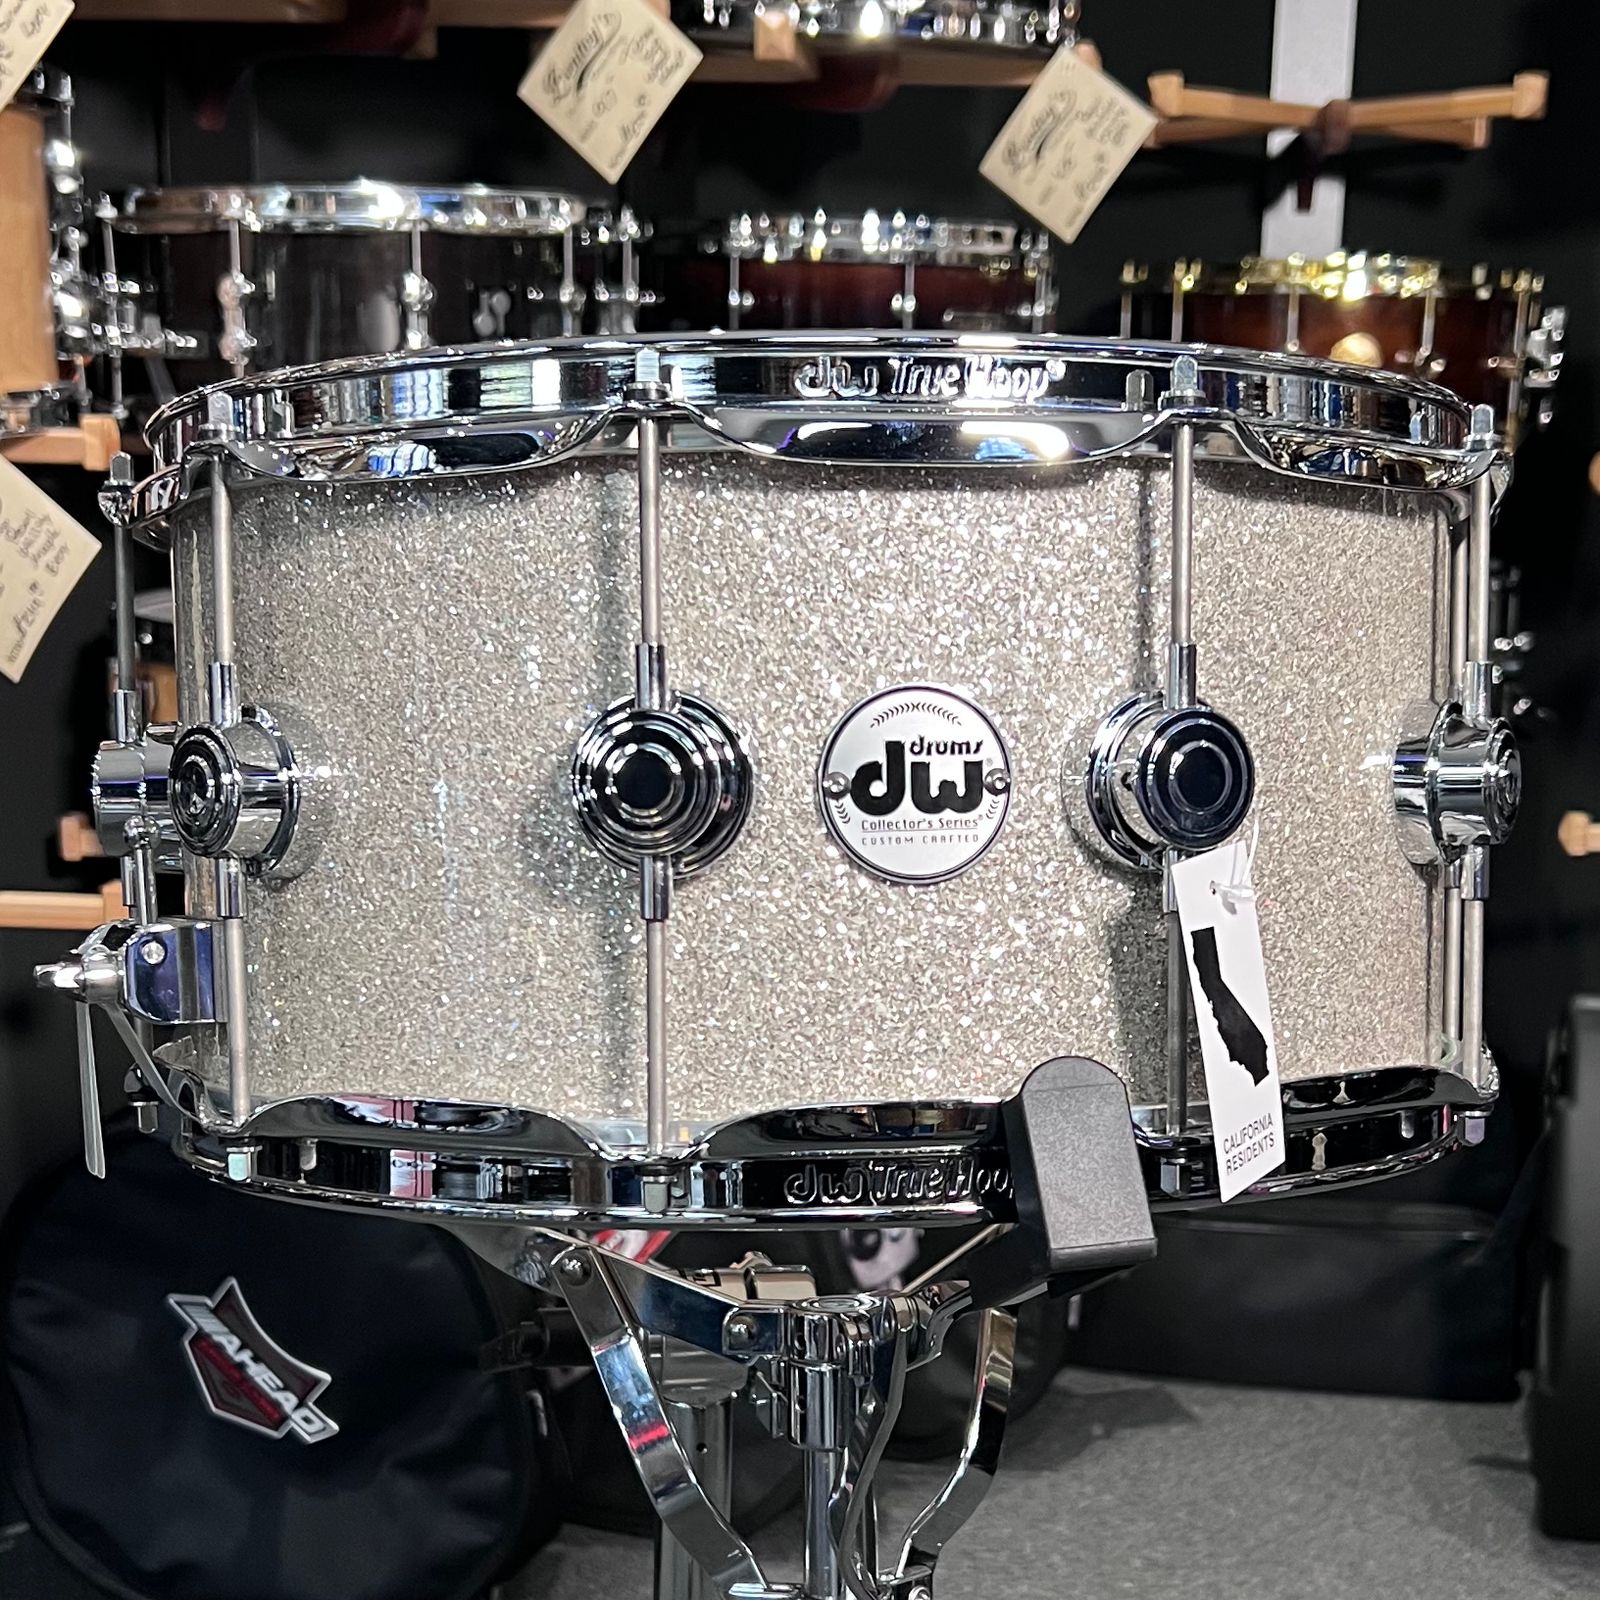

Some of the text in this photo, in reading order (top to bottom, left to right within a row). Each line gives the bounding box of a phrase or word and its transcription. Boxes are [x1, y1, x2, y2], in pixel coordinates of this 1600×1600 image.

[887, 355, 960, 396] True
[909, 734, 984, 756] drums
[850, 740, 984, 816] dw
[861, 818, 934, 831] Collector's
[861, 834, 979, 846] CUSTOM CRAFTED
[1223, 1112, 1274, 1155] CALIFORNIA
[1225, 1132, 1275, 1176] RESIDENTS
[874, 1163, 944, 1199] True
[944, 1158, 1015, 1200] Hoo
[209, 1332, 327, 1435] AHEAD
